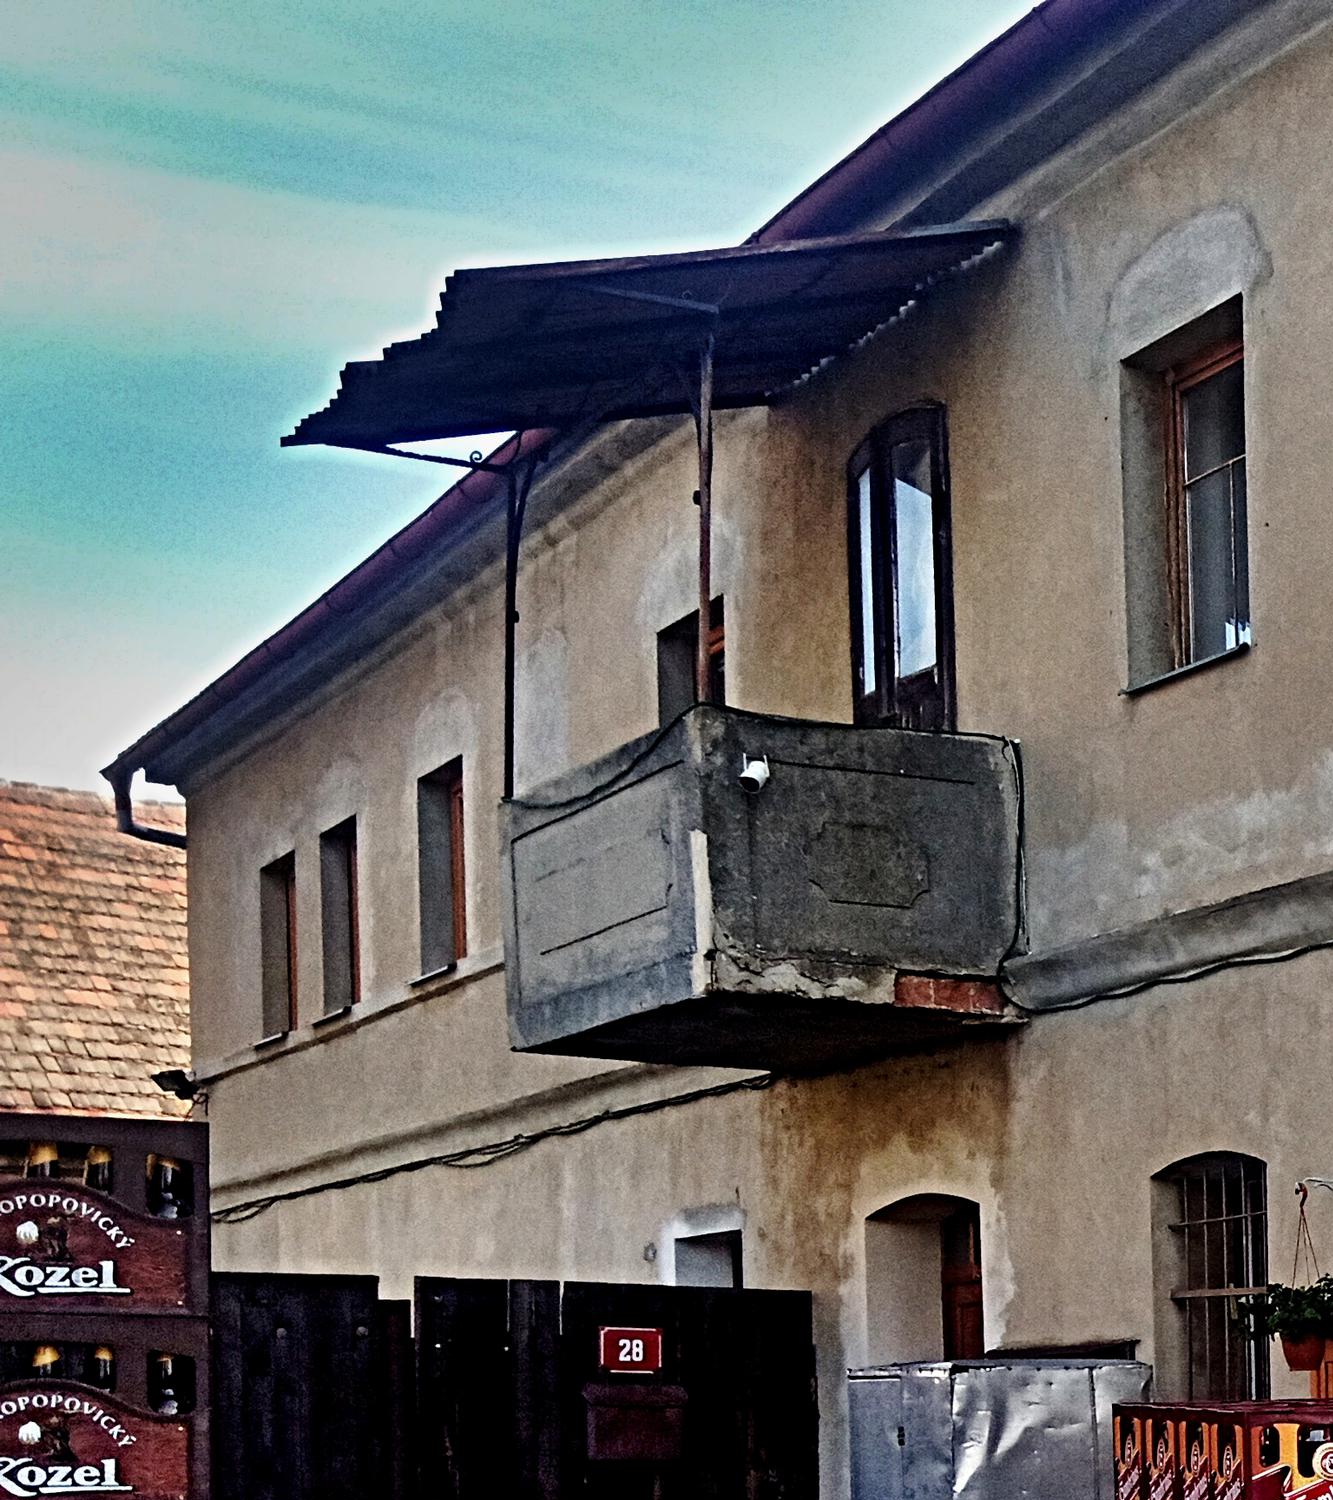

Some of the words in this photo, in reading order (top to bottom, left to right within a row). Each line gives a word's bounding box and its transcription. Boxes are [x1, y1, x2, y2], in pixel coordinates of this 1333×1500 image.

[0, 1193, 135, 1248] OPOPOVICKÝ
[618, 1338, 644, 1362] 28
[0, 1394, 137, 1447] OPOPOVICKÝ
